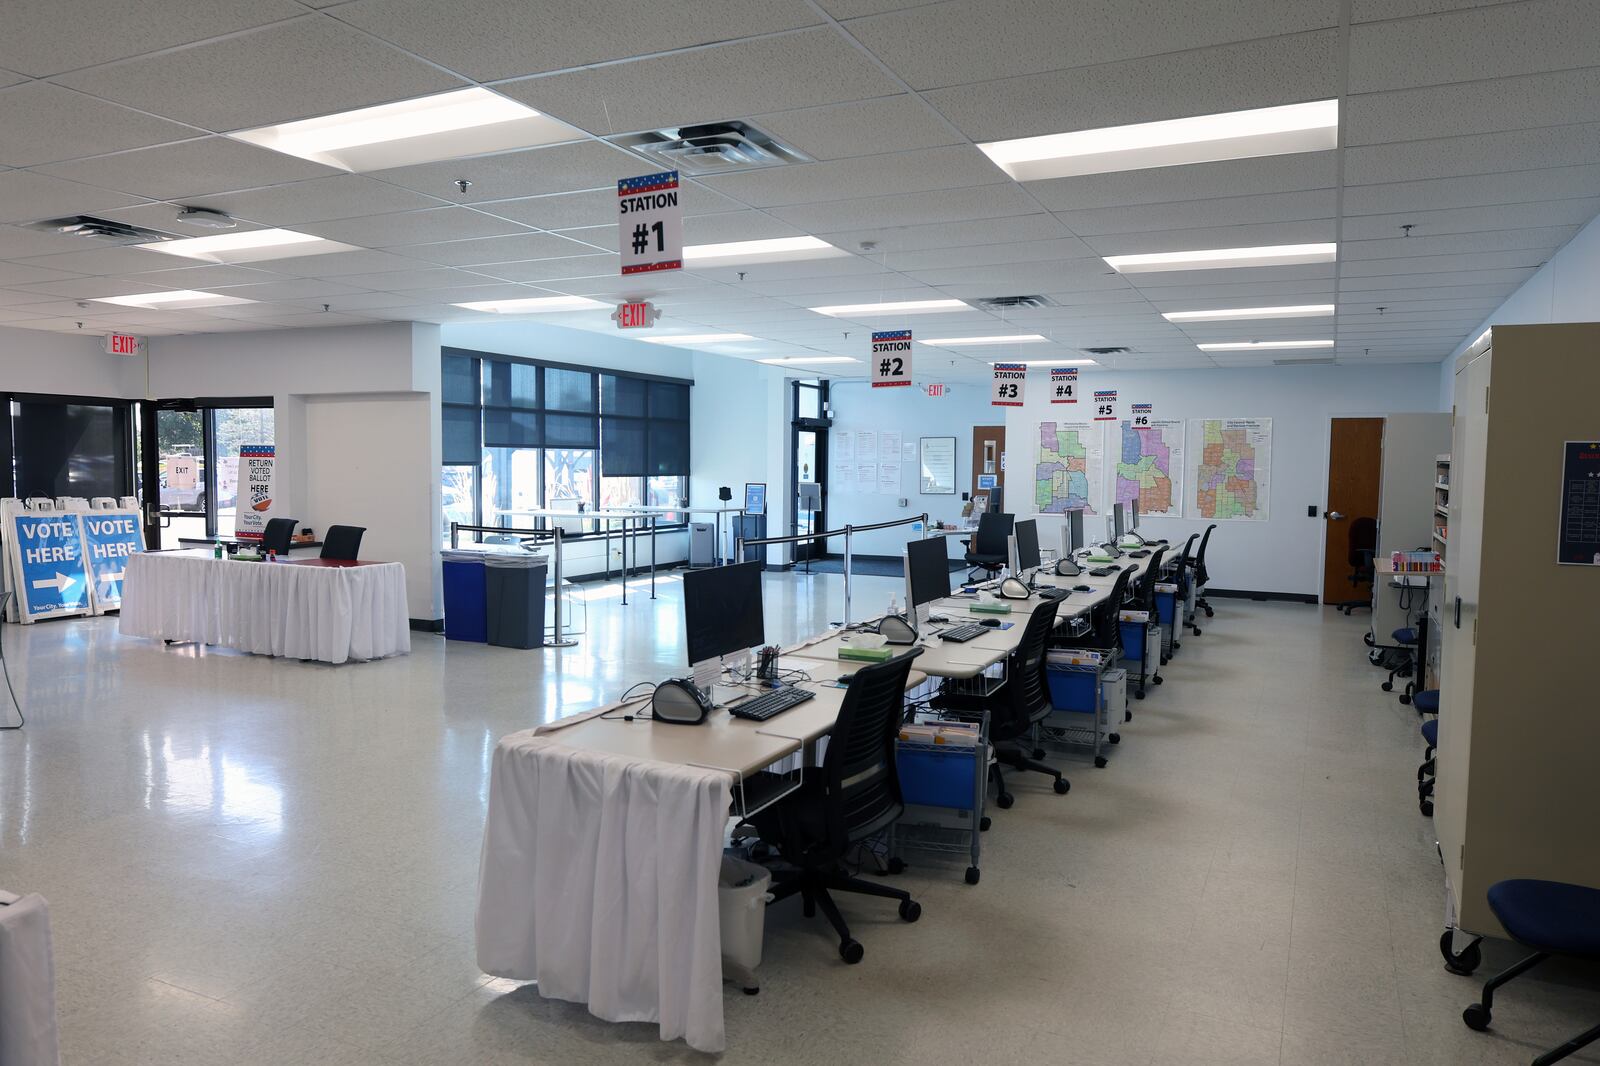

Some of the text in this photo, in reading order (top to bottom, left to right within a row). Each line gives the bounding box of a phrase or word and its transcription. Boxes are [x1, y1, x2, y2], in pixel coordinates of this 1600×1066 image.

[620, 191, 678, 214] STATION
[632, 221, 665, 255] #1
[622, 303, 647, 327] EXIT
[112, 335, 134, 354] EXIT
[873, 342, 911, 353] STATION
[880, 358, 904, 376] #2
[994, 372, 1025, 380] STATION
[928, 384, 943, 396] EXIT
[998, 384, 1018, 398] #3
[1056, 385, 1072, 397] #4
[1098, 405, 1113, 415] #5
[1135, 416, 1148, 425] #6
[175, 466, 188, 474] EXIT
[248, 459, 273, 467] RETURN
[22, 522, 73, 539] VOTE
[88, 519, 135, 536] VOTE
[26, 546, 75, 564] HERE
[93, 541, 136, 558] HERE
